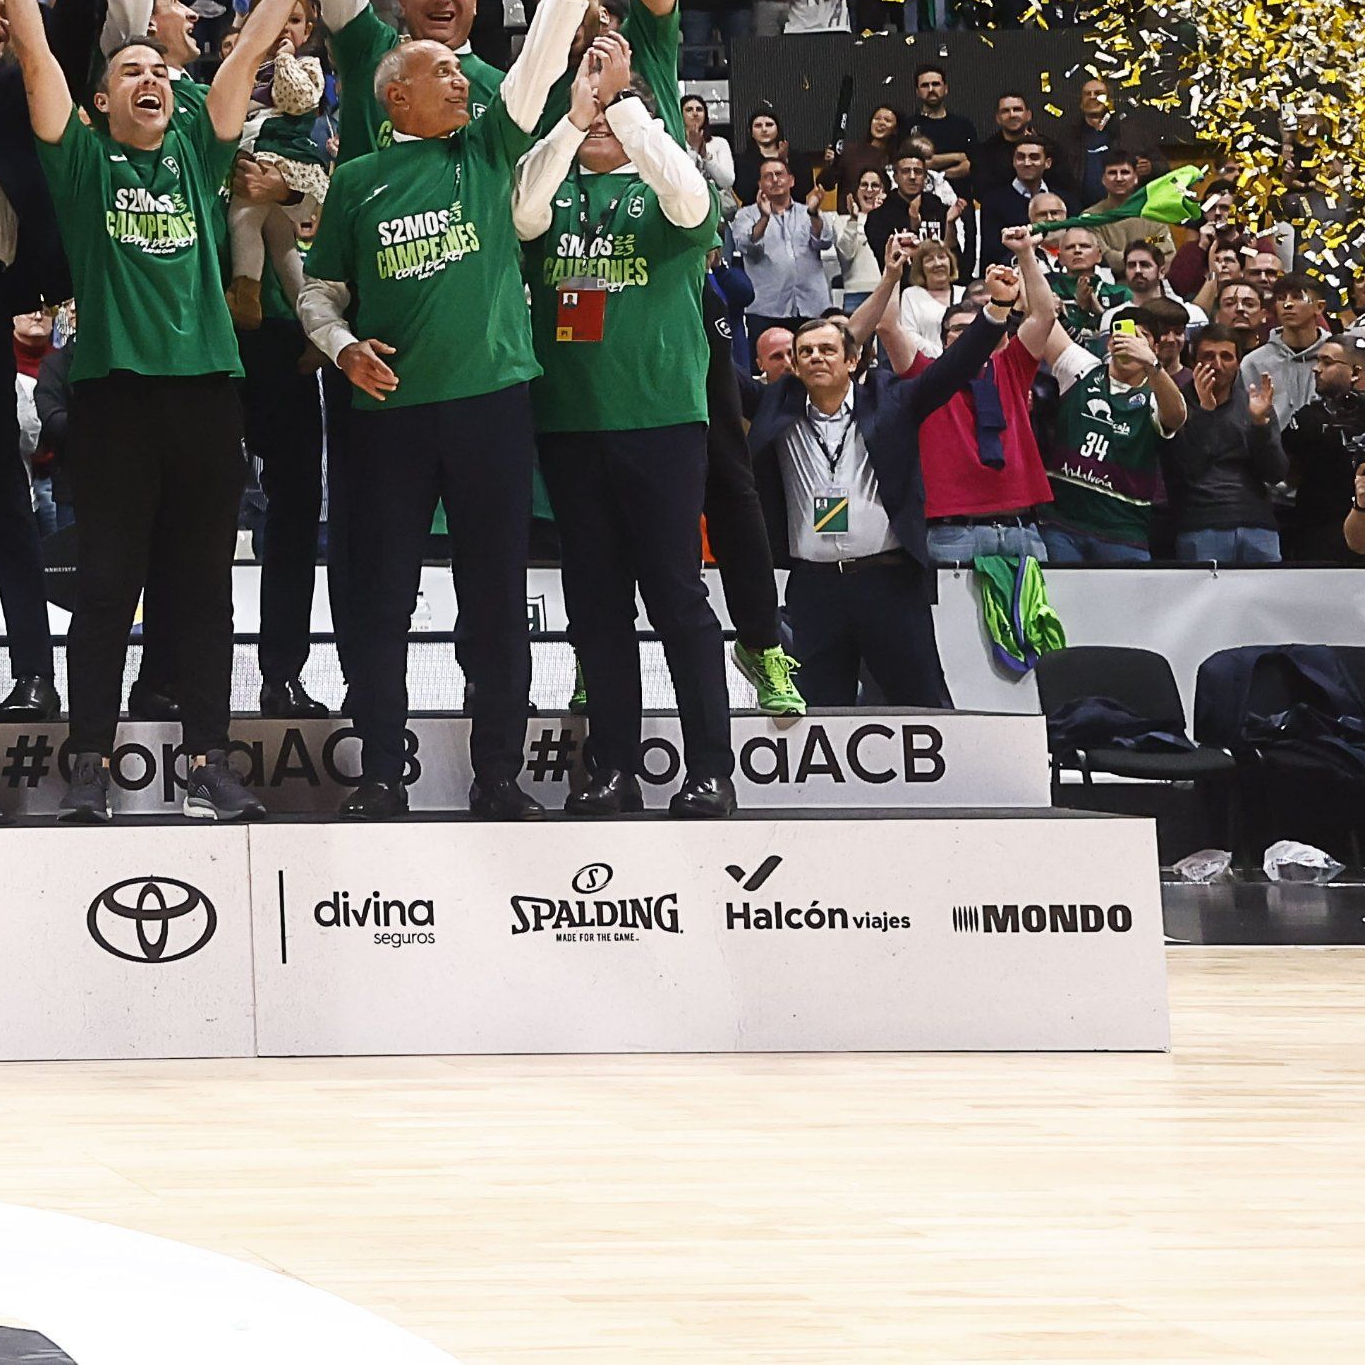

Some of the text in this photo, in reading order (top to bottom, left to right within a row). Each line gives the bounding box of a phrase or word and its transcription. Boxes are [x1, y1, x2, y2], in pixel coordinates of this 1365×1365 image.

[106, 210, 198, 240] CAMPENE
[378, 209, 451, 247] S2MOS
[1080, 431, 1110, 463] 34
[525, 724, 947, 786] #oaACB
[314, 891, 435, 928] divina
[511, 892, 680, 935] SPALDING
[726, 900, 911, 933] Halcón viajes
[982, 904, 1133, 934] MONDO
[374, 932, 436, 949] seguros
[566, 933, 587, 943] MADE
[590, 933, 604, 942] FOR
[607, 933, 622, 942] THE
